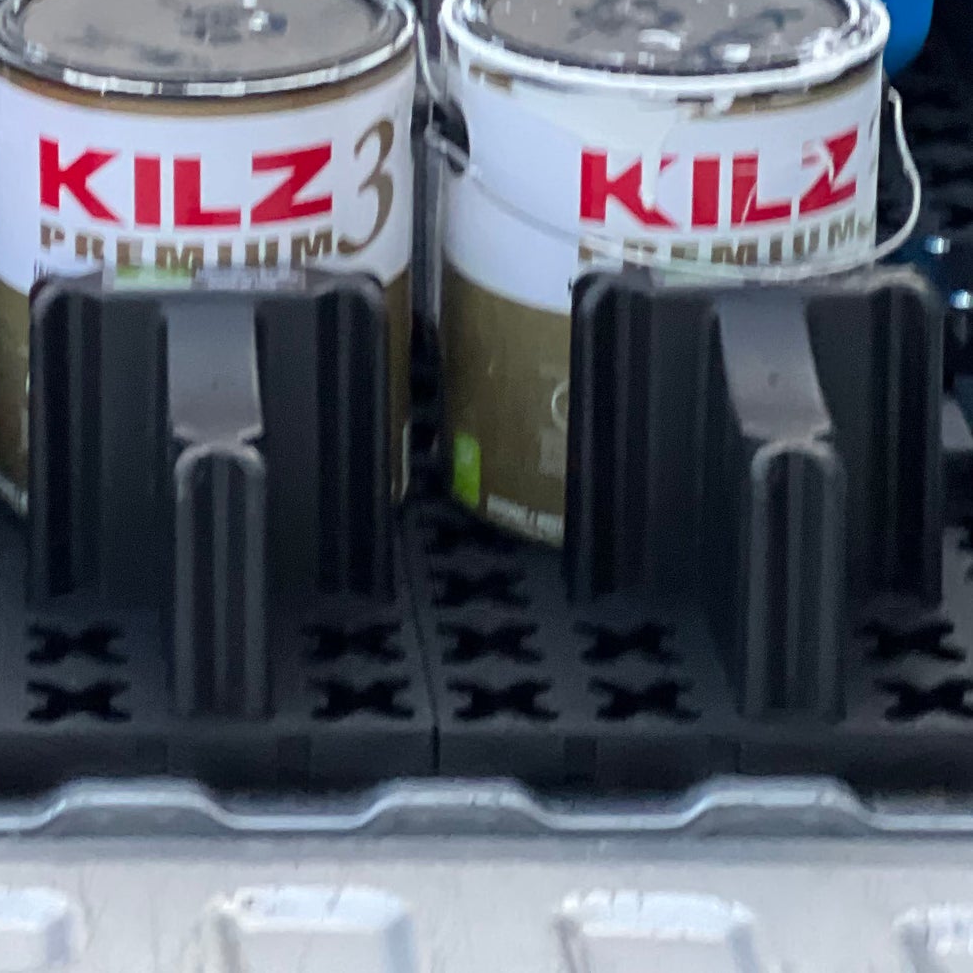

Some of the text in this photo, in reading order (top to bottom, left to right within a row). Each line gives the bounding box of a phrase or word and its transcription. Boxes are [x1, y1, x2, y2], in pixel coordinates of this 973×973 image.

[39, 118, 396, 255] KILZ 3
[579, 125, 858, 231] KILZ
